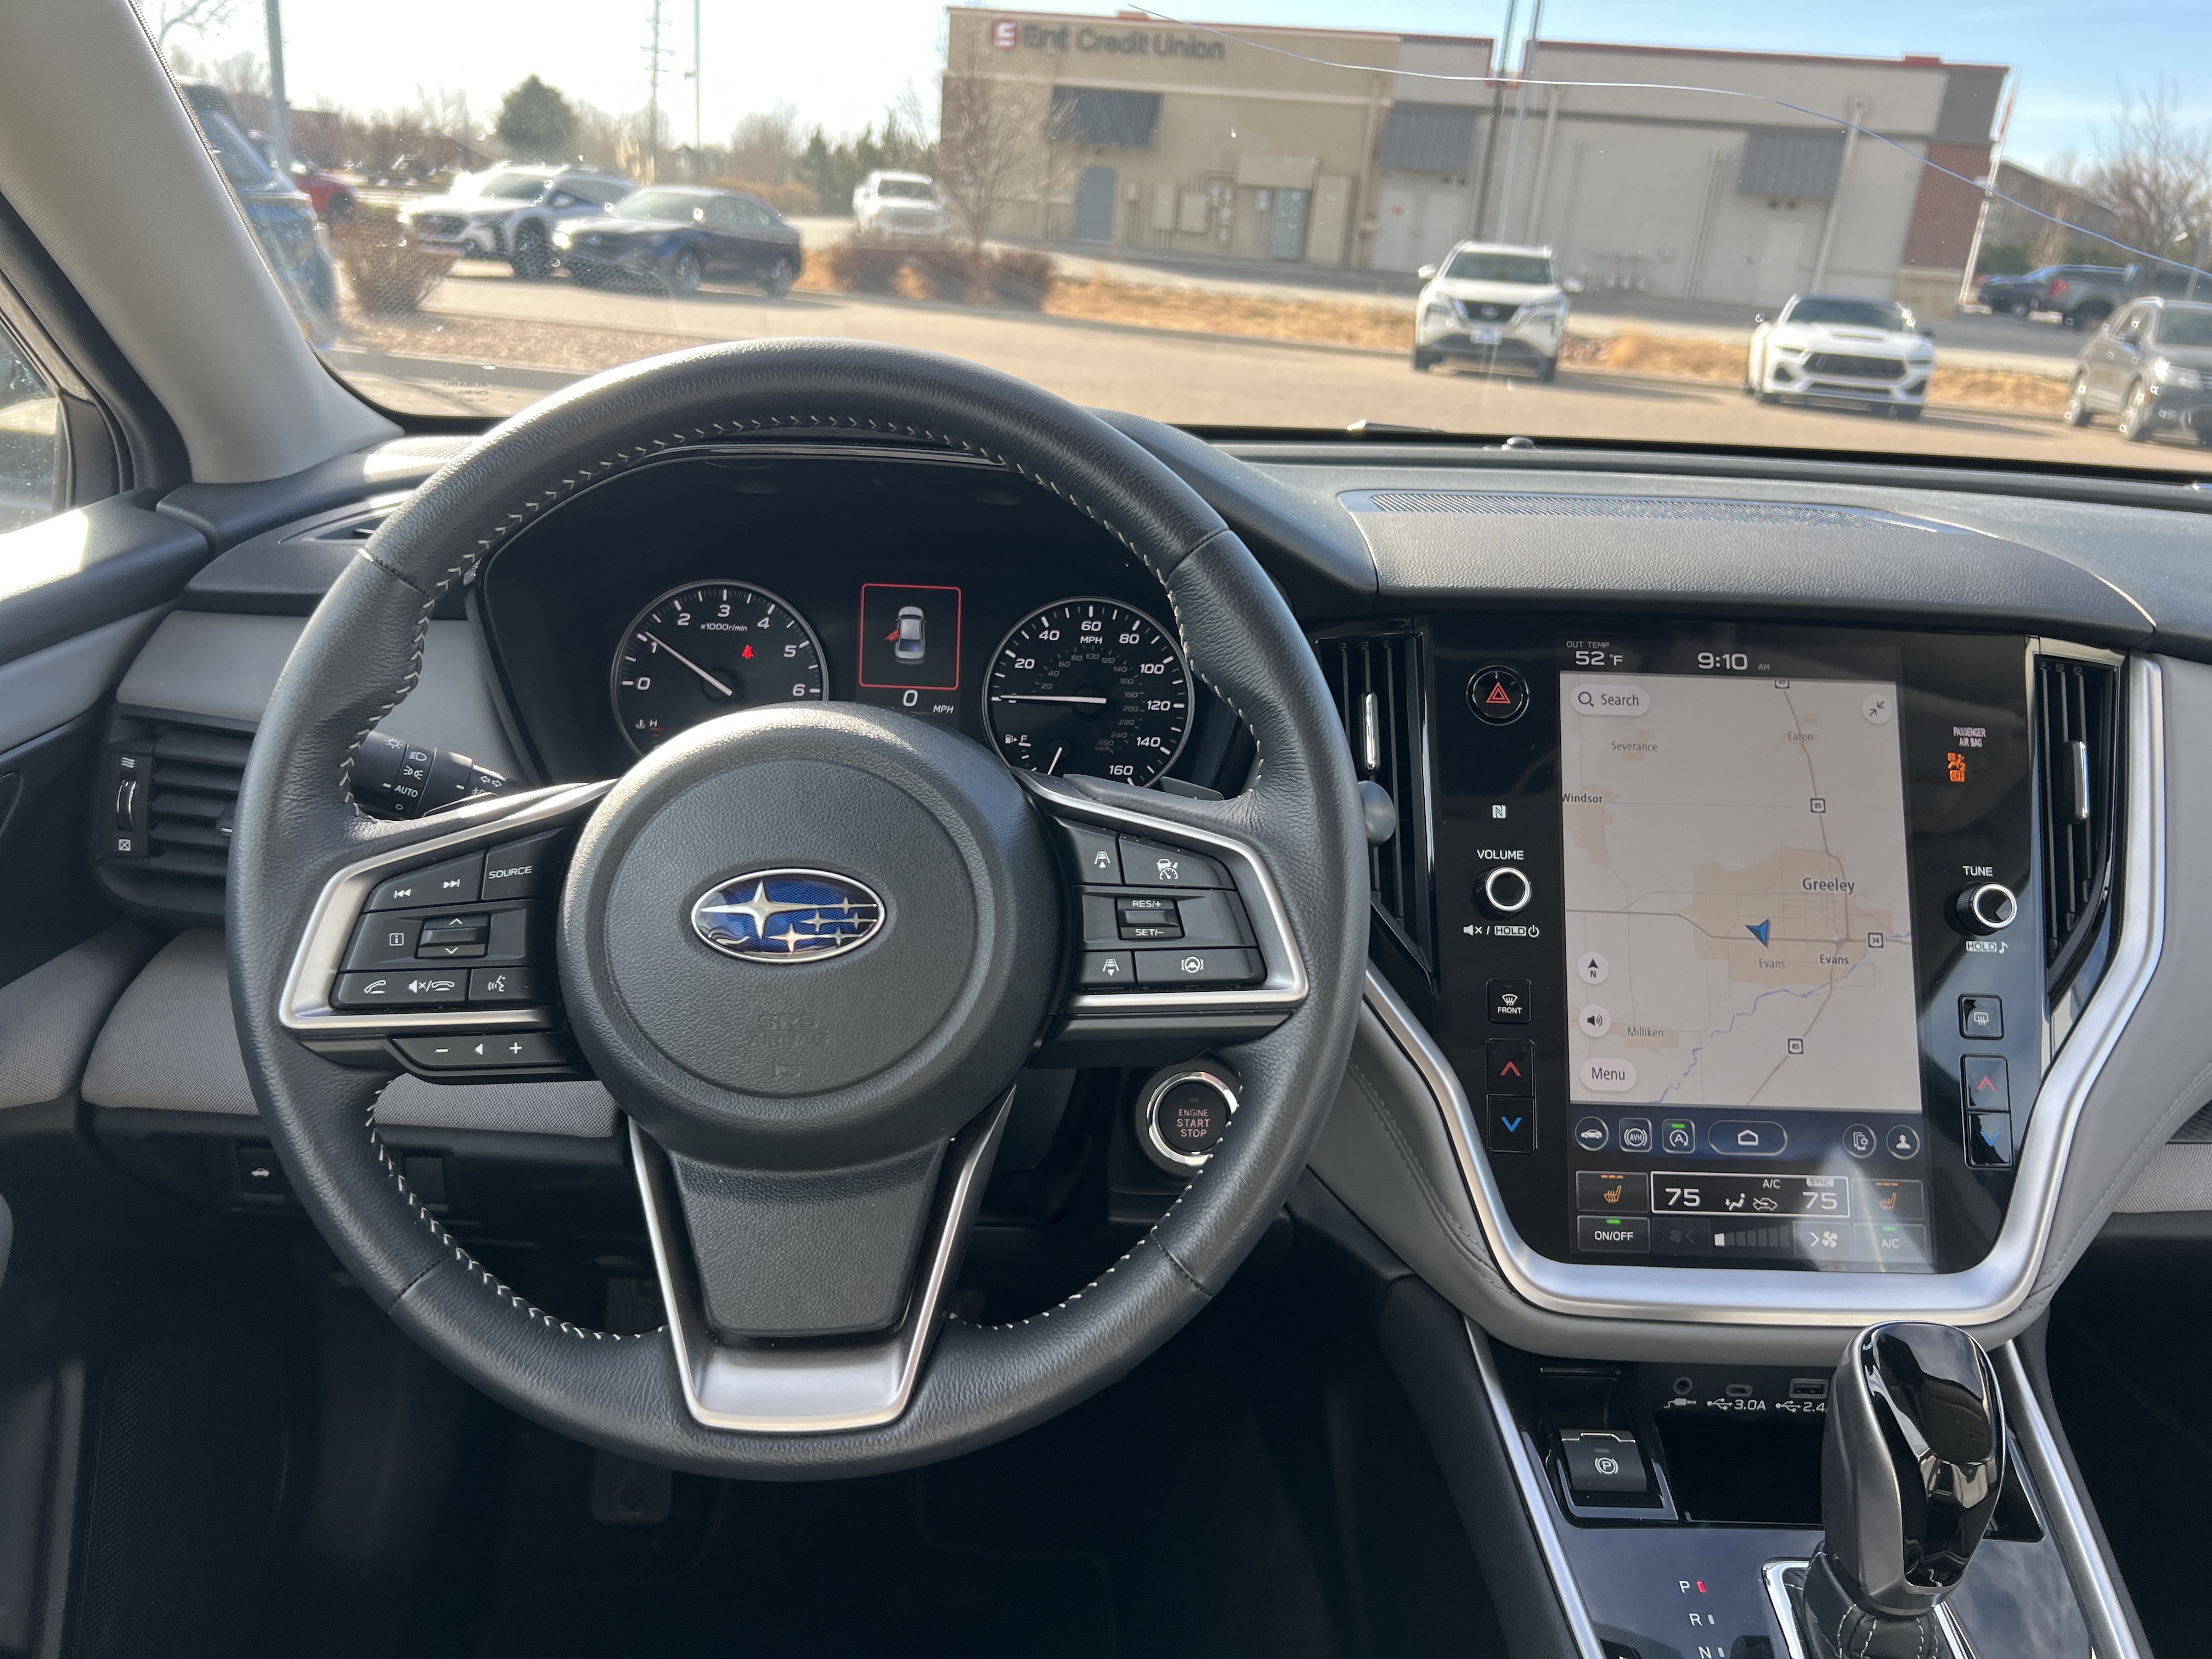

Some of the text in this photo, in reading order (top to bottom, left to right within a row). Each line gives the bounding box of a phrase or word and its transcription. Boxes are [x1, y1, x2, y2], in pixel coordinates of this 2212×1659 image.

[1022, 24, 1069, 50] Ent
[1076, 27, 1148, 54] Credit
[1153, 29, 1226, 60] Union
[718, 605, 731, 618] 3
[678, 613, 691, 626] 2
[757, 618, 770, 629] 4
[1081, 621, 1102, 631] 60
[1039, 630, 1060, 641] 40
[1080, 636, 1103, 644] MPH
[1119, 634, 1140, 644] 80
[651, 642, 658, 654] 1
[1566, 641, 1610, 650] OUT TEMP
[783, 645, 797, 658] 5
[1014, 658, 1035, 669] 20
[1575, 651, 1605, 666] 52
[1697, 652, 1749, 670] 9:10
[1139, 664, 1165, 674] 100
[636, 677, 651, 691] 0
[792, 684, 806, 697] 6
[902, 690, 919, 707] 0
[1601, 693, 1639, 707] Search
[933, 704, 954, 714] MPH
[1146, 700, 1171, 711] 120
[1787, 731, 1813, 742] Eaton
[1953, 726, 1987, 738] PASSENGER
[1136, 737, 1161, 747] 140
[1611, 741, 1658, 752] Severance
[1959, 737, 1983, 747] AIR BAG
[1109, 765, 1133, 776] 160
[1951, 770, 1964, 780] OFF
[394, 785, 418, 798] AUTO
[1562, 792, 1604, 803] Windsor
[1476, 849, 1524, 860] VOLUME
[488, 865, 533, 879] SOURCE
[1962, 866, 1993, 877] TUNE
[1802, 877, 1855, 896] Greeley
[1132, 899, 1162, 908] RES/+
[1496, 927, 1525, 935] HOLD
[1870, 936, 1881, 945] 34
[1967, 942, 1996, 952] HOLD
[1758, 957, 1786, 969] Evans
[1819, 953, 1849, 966] Evans
[1590, 969, 1597, 978] N
[1497, 1006, 1522, 1014] FRONT
[1627, 1026, 1664, 1038] Milliken
[1591, 1067, 1626, 1081] Menu
[1177, 1119, 1210, 1127] START
[1181, 1128, 1207, 1138] STOP
[1630, 1133, 1642, 1142] AVH
[1762, 1178, 1781, 1189] A/C
[1664, 1187, 1701, 1207] 75
[1802, 1191, 1838, 1210] 75
[1594, 1230, 1634, 1242] ON/OFF
[1881, 1238, 1899, 1249] A/C
[1734, 1400, 1766, 1411] 3.0A
[1803, 1402, 1827, 1413] 2.4
[1679, 1580, 1690, 1593] P
[1689, 1613, 1702, 1626] R
[1699, 1646, 1712, 1659] N
